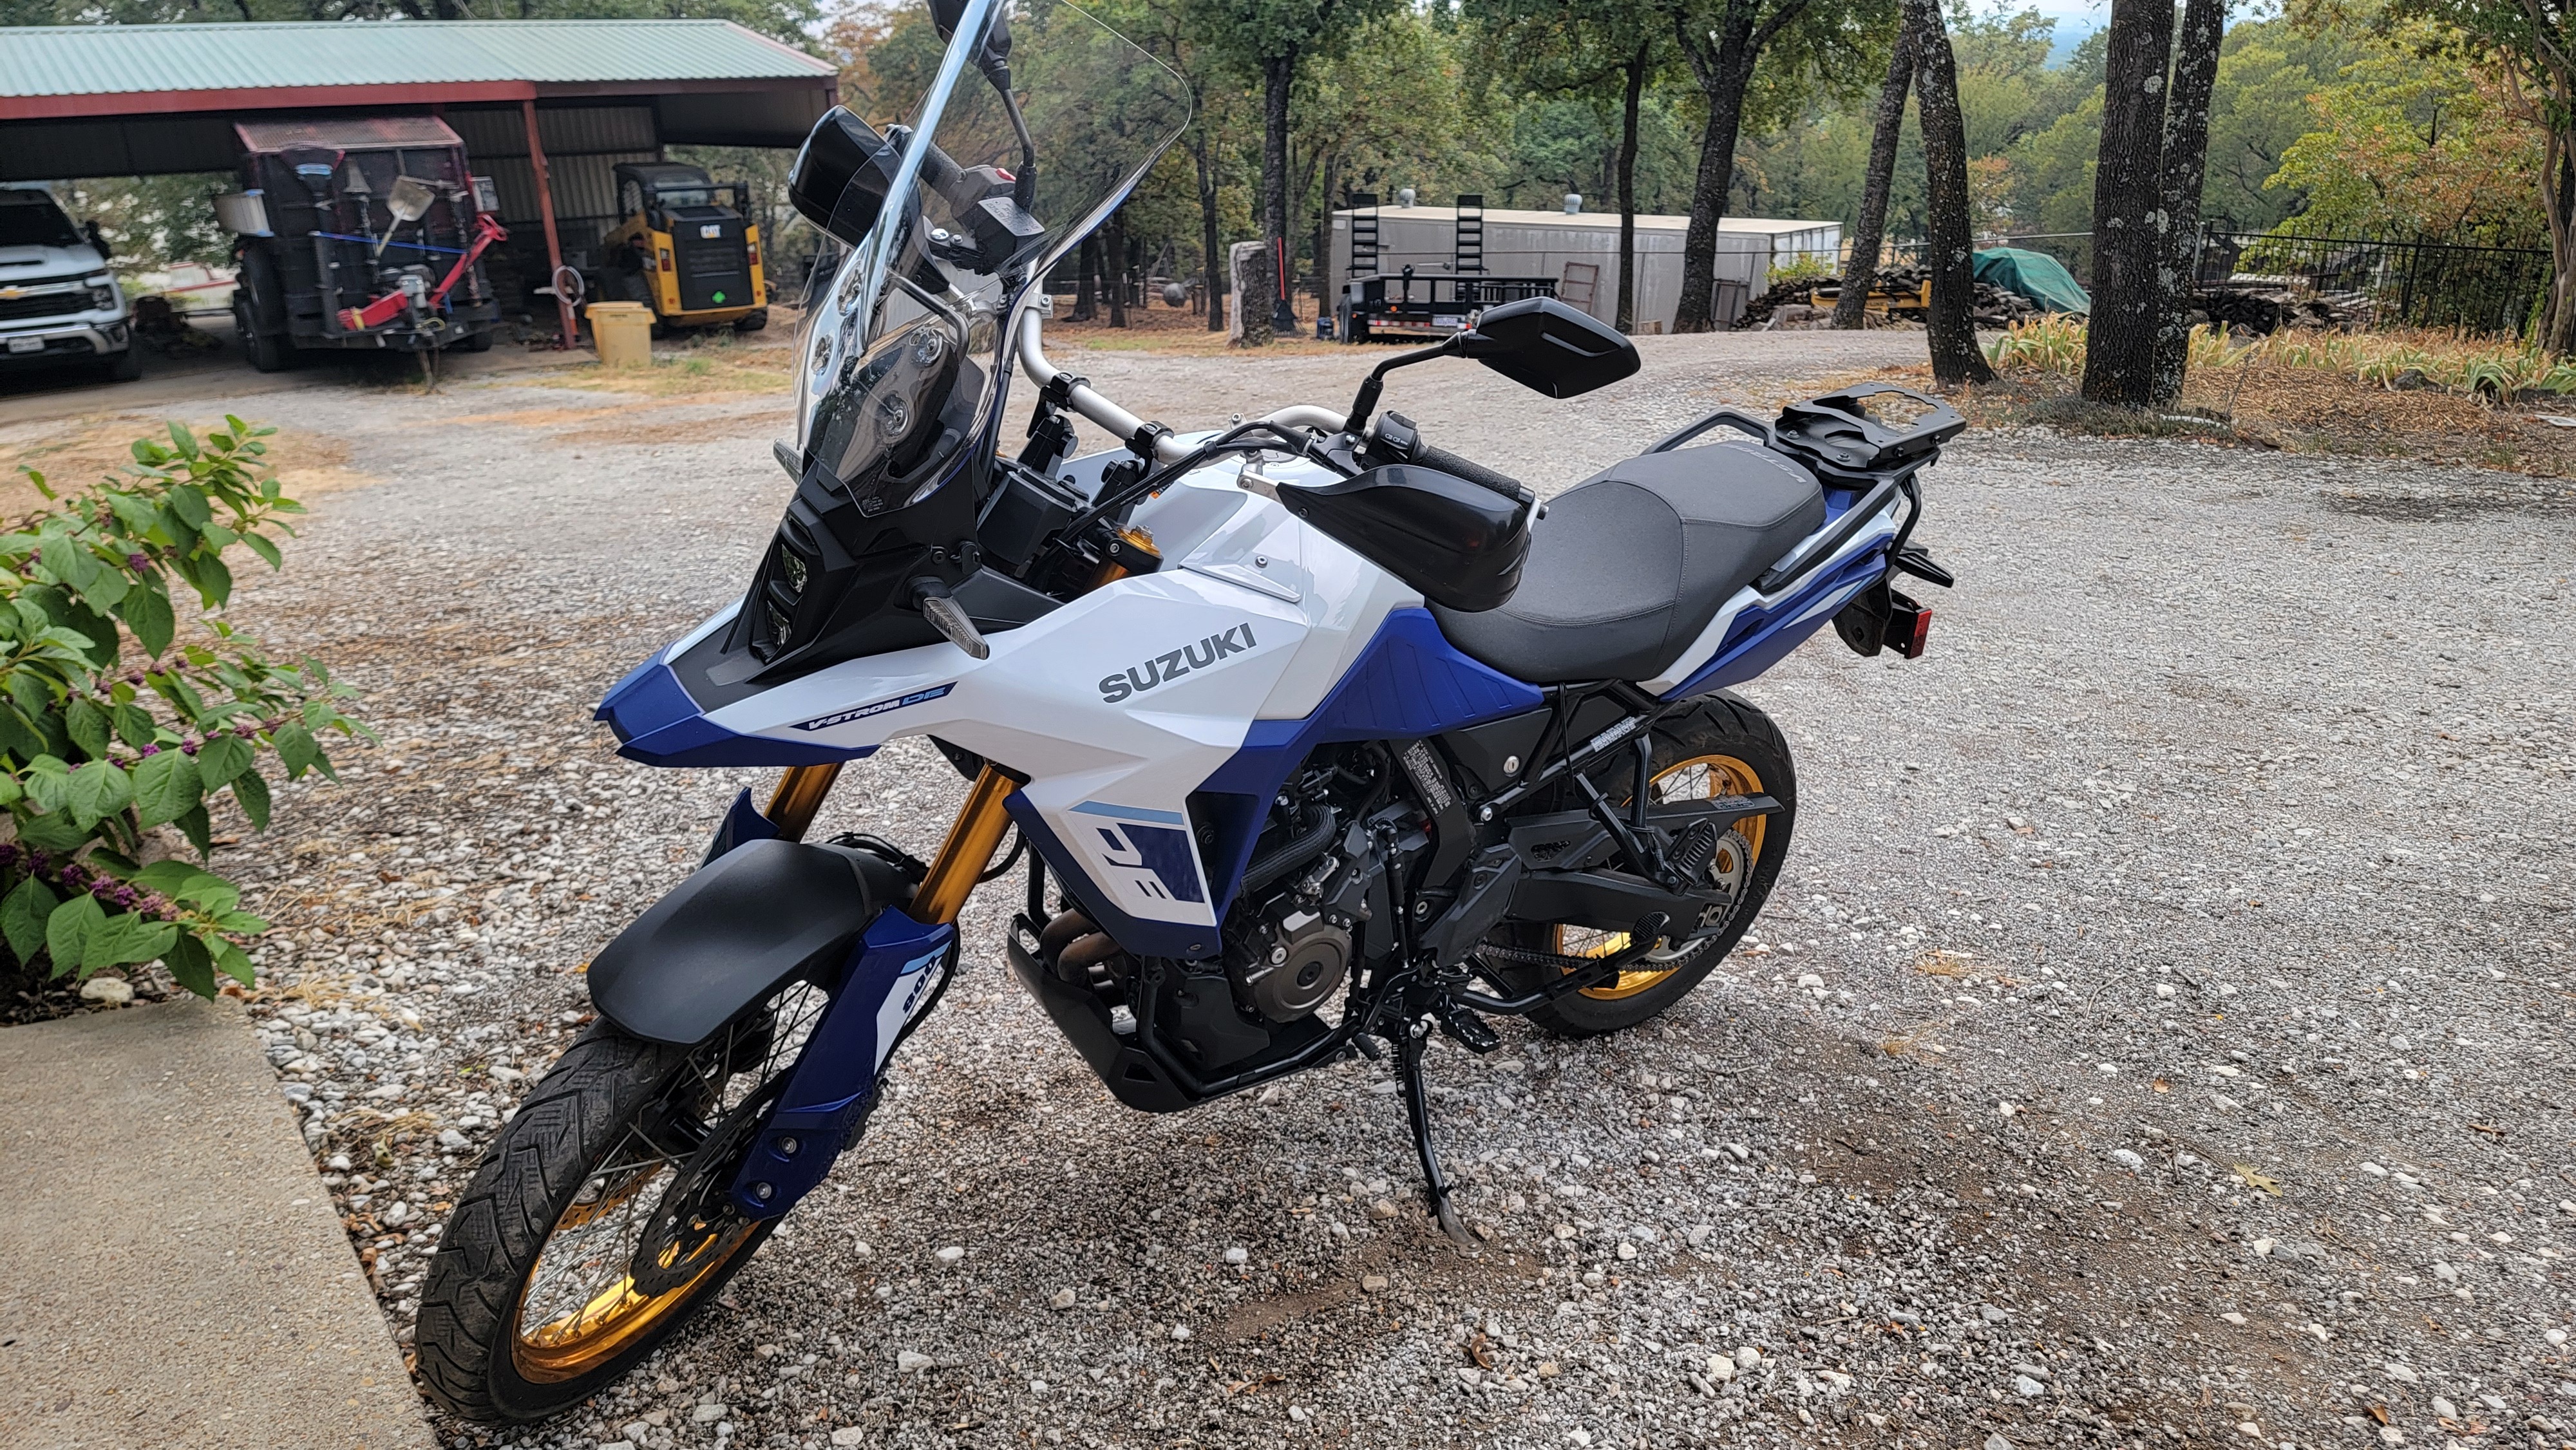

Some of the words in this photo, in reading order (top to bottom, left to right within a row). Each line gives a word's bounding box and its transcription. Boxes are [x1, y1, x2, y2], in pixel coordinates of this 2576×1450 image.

[1098, 622, 1257, 704] SUZUKI
[808, 699, 901, 730] V-STROM
[902, 955, 936, 1014] 800
